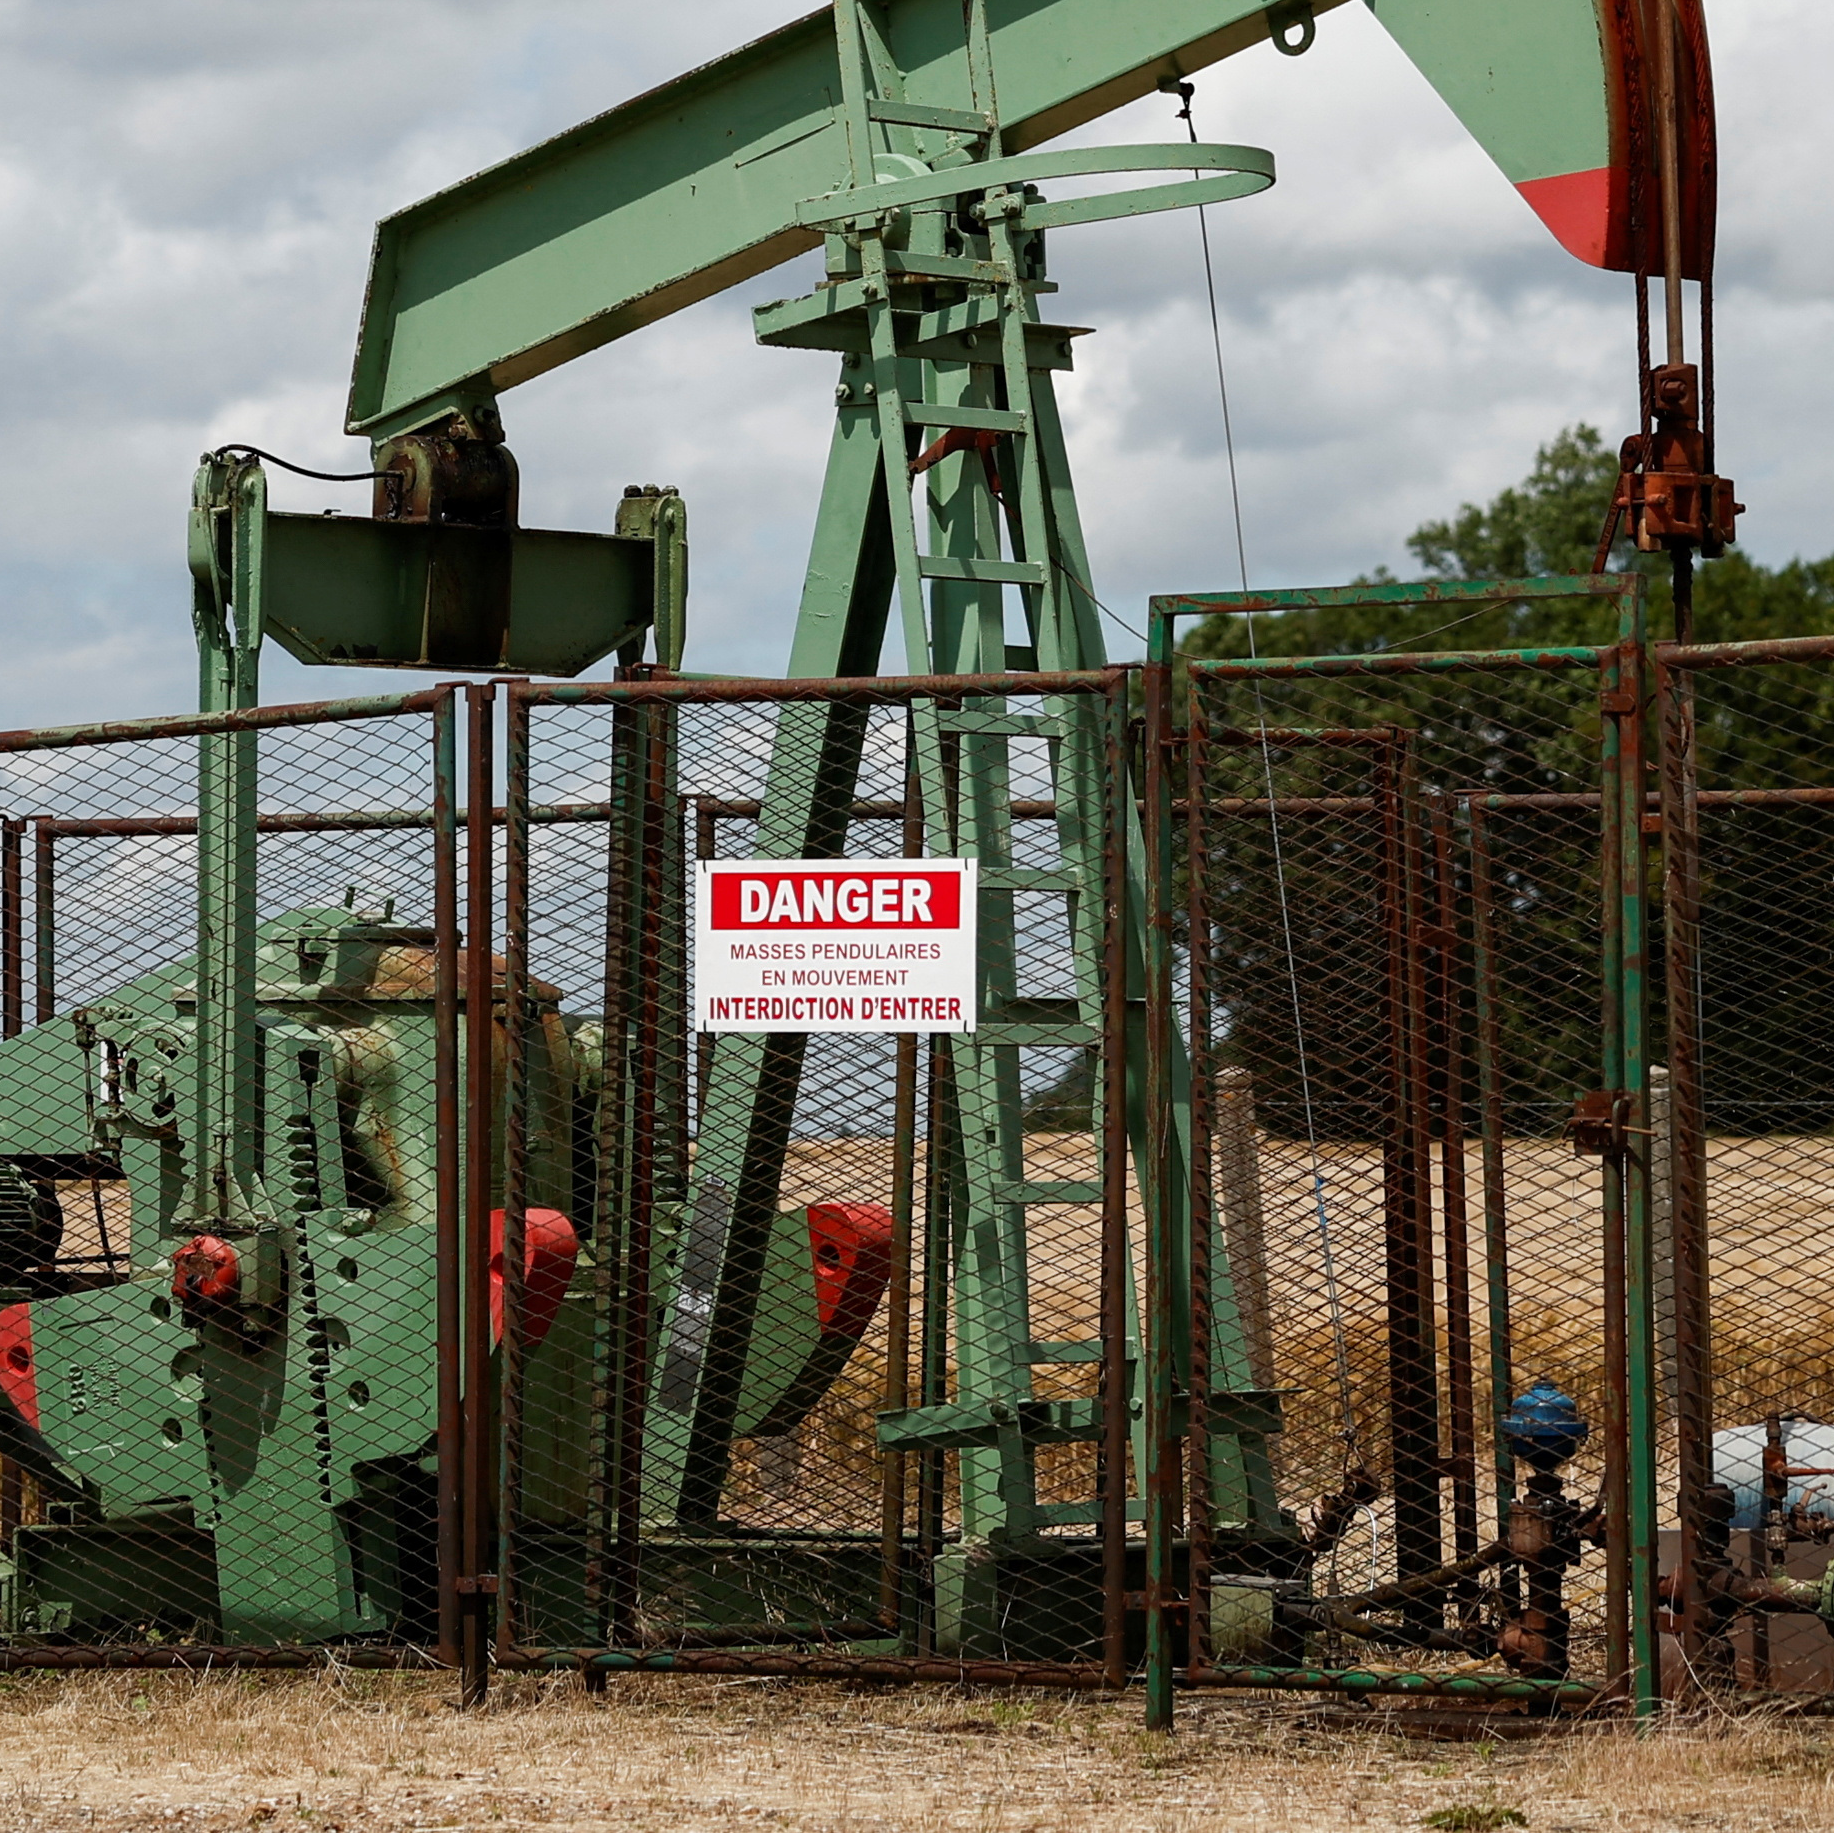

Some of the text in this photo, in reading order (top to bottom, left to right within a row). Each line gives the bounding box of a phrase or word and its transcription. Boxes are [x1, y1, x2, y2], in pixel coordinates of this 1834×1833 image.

[740, 878, 933, 923] DANGER
[730, 943, 941, 960] MASSES PENDULAIRES
[761, 969, 909, 986] EN MOUVEMENT
[709, 996, 962, 1021] INTERDICTION D’ENTRER
